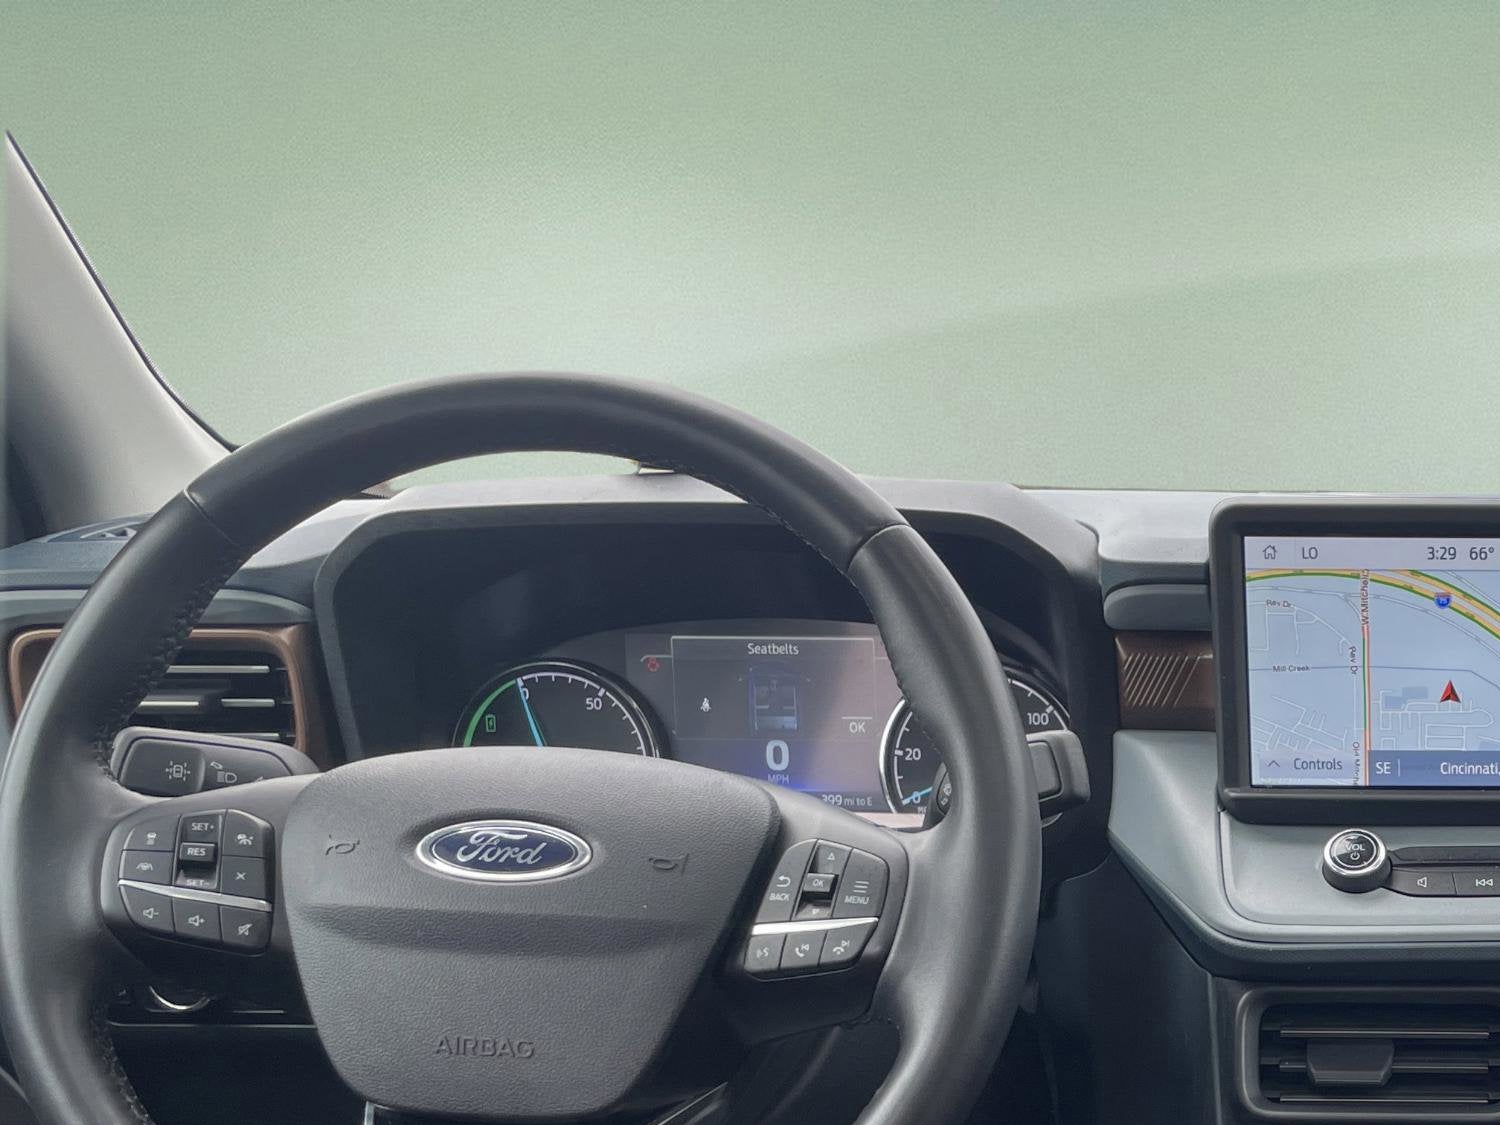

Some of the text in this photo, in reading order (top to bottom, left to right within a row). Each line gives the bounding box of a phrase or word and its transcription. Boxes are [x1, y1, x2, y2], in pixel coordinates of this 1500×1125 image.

[1301, 547, 1319, 560] LO
[1426, 546, 1495, 561] 3:29 66°
[747, 642, 800, 656] Seatbelts
[585, 697, 603, 711] 50
[1026, 712, 1050, 726] 100
[849, 721, 866, 734] OK
[765, 739, 790, 772] 0
[904, 748, 922, 761] 20
[1293, 757, 1343, 771] Controls
[1375, 761, 1392, 775] SE
[767, 773, 790, 785] MPH
[844, 797, 855, 807] mi
[856, 797, 866, 806] to
[186, 847, 207, 857] RES
[456, 829, 548, 865] Ford
[1344, 843, 1366, 851] VOL
[812, 879, 824, 888] OK
[769, 893, 791, 902] BACK
[844, 895, 870, 905] MENU
[435, 1034, 535, 1059] AIRBAG
